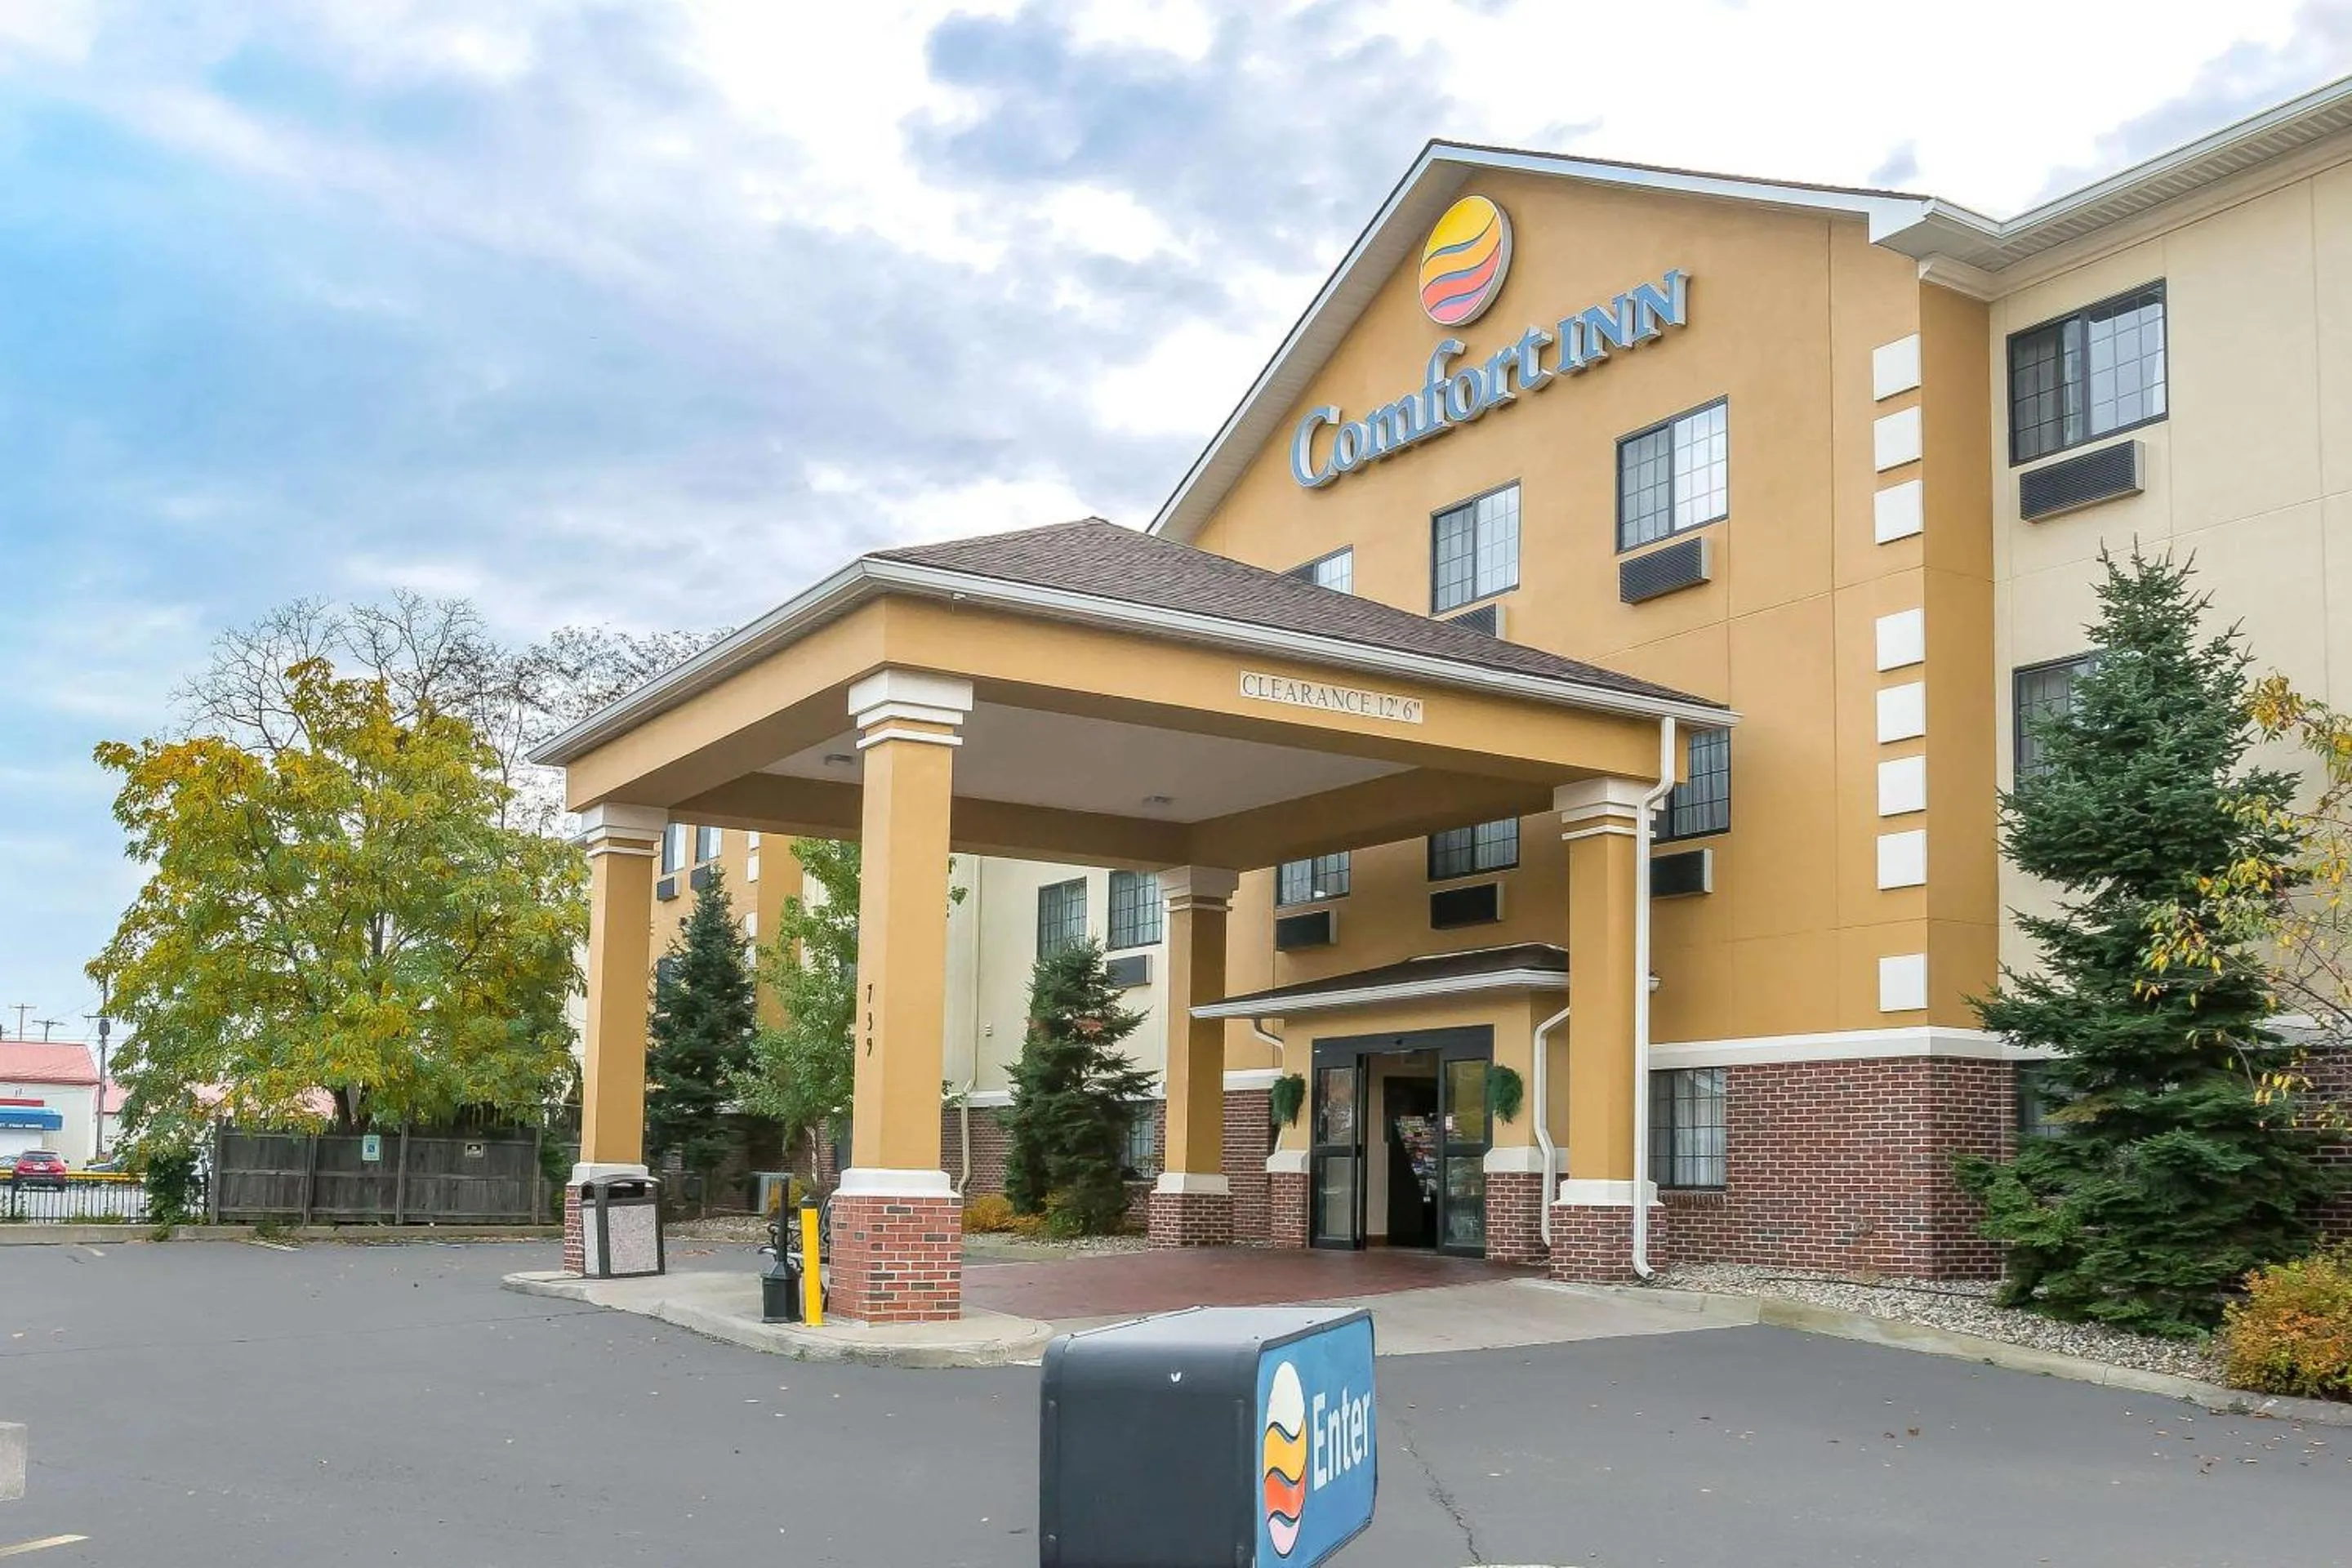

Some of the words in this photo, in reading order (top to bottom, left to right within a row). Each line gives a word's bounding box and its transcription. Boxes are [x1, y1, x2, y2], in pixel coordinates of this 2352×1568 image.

[1290, 326, 1553, 489] Comfort
[1557, 269, 1693, 376] INN
[1242, 675, 1372, 715] CLEARANCE
[1379, 697, 1399, 718] 12'
[1312, 1386, 1371, 1492] Enter
